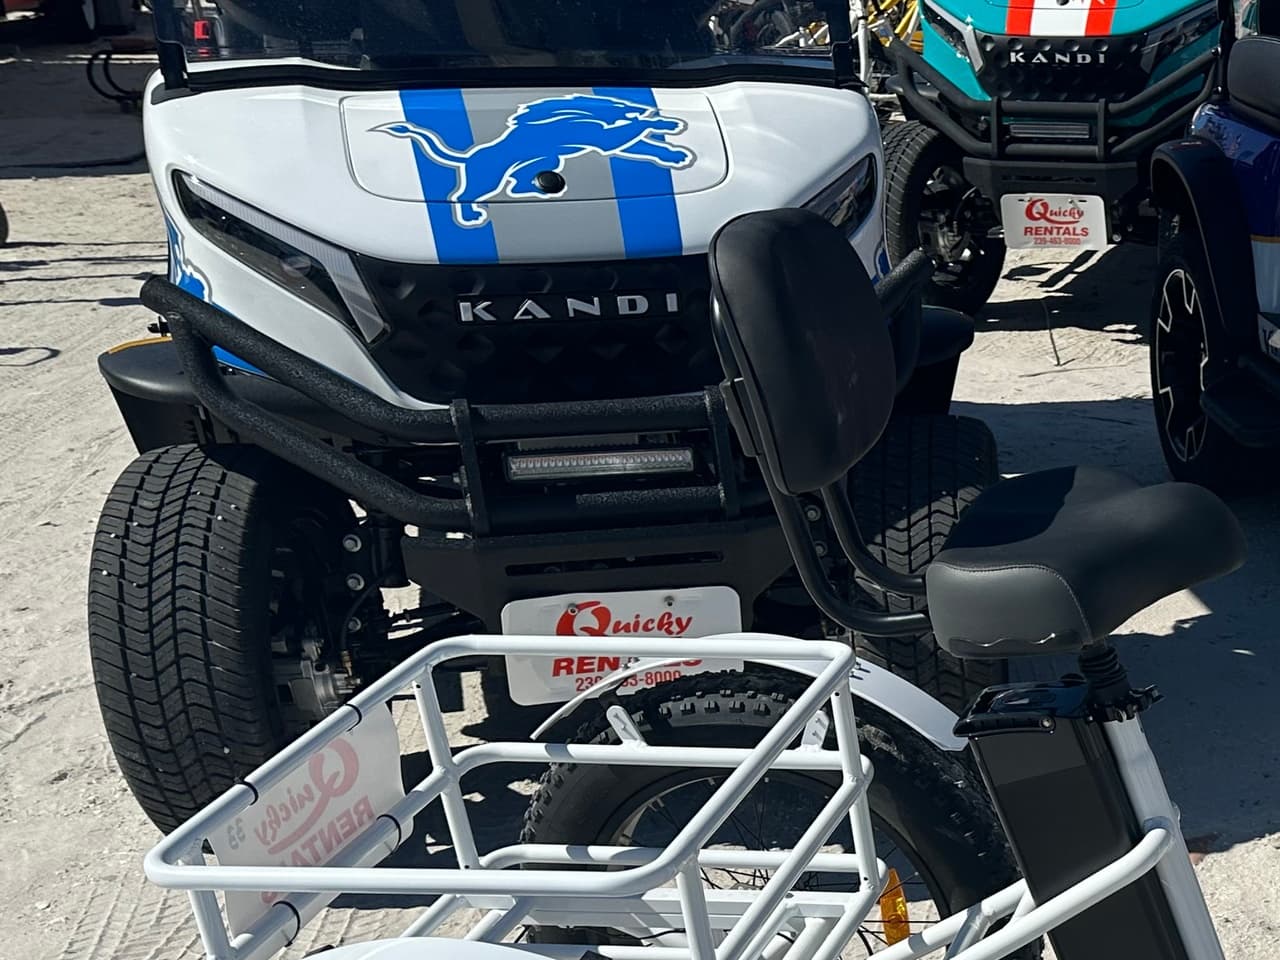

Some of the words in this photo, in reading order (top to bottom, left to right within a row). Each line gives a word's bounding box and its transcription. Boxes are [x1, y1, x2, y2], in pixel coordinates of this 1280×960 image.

[1010, 52, 1105, 64] KANDI
[1025, 198, 1085, 225] Quicky
[1024, 226, 1089, 237] RENTALS
[459, 293, 679, 322] KANDI
